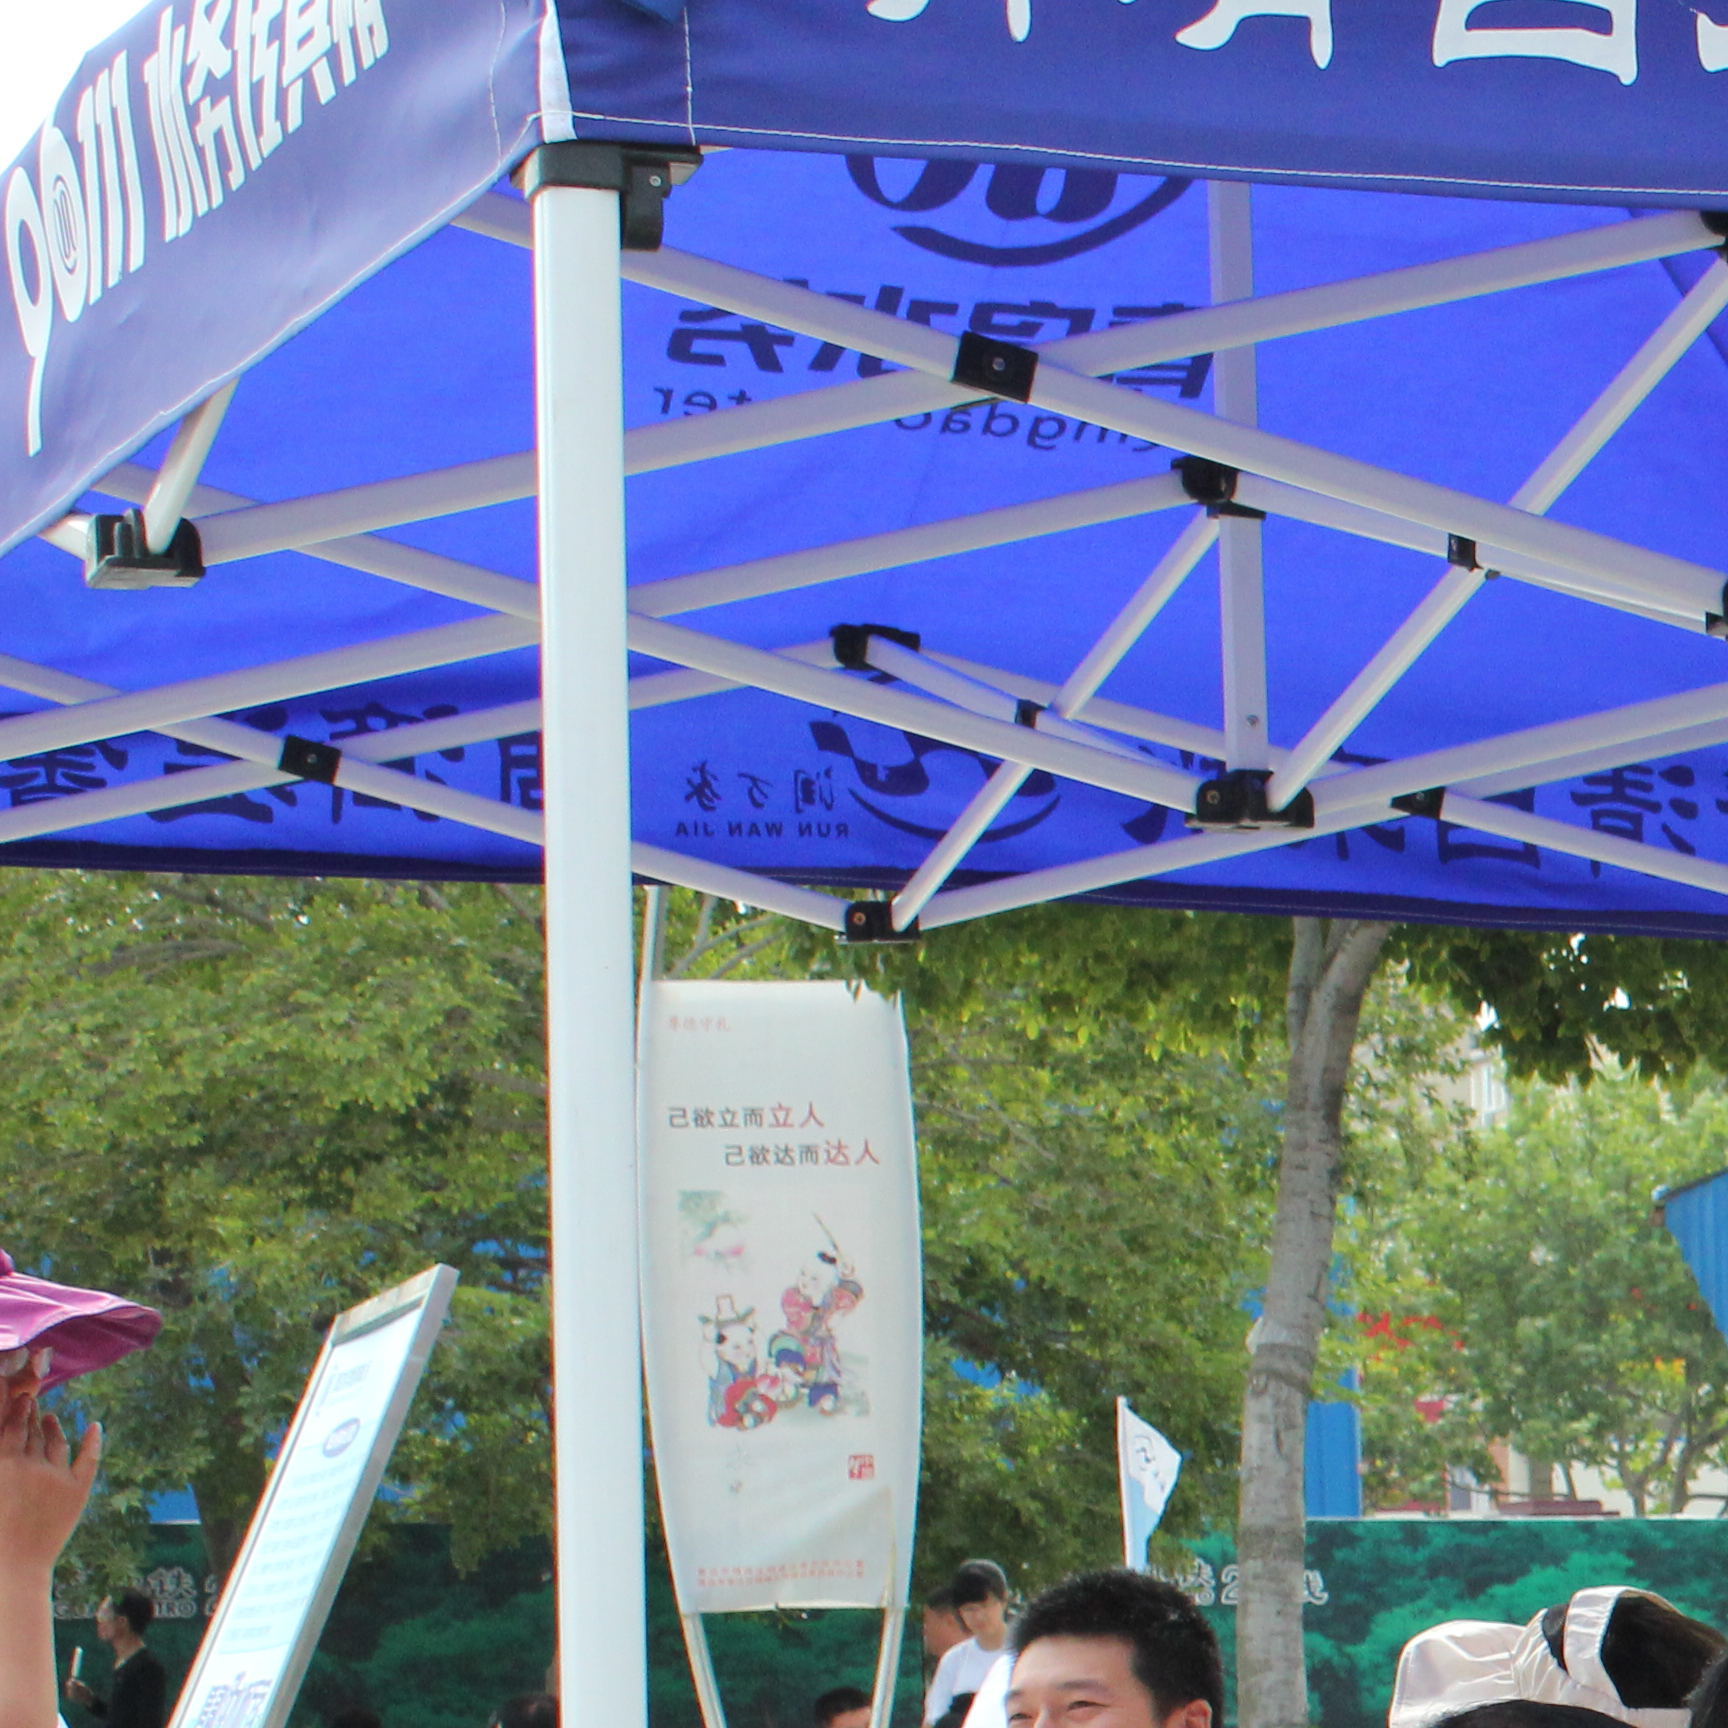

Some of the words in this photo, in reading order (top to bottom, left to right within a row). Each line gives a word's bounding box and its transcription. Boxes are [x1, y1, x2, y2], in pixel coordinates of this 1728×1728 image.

[668, 1101, 825, 1129] 己欲立而立人
[724, 1138, 881, 1166] 己欲达而达人
